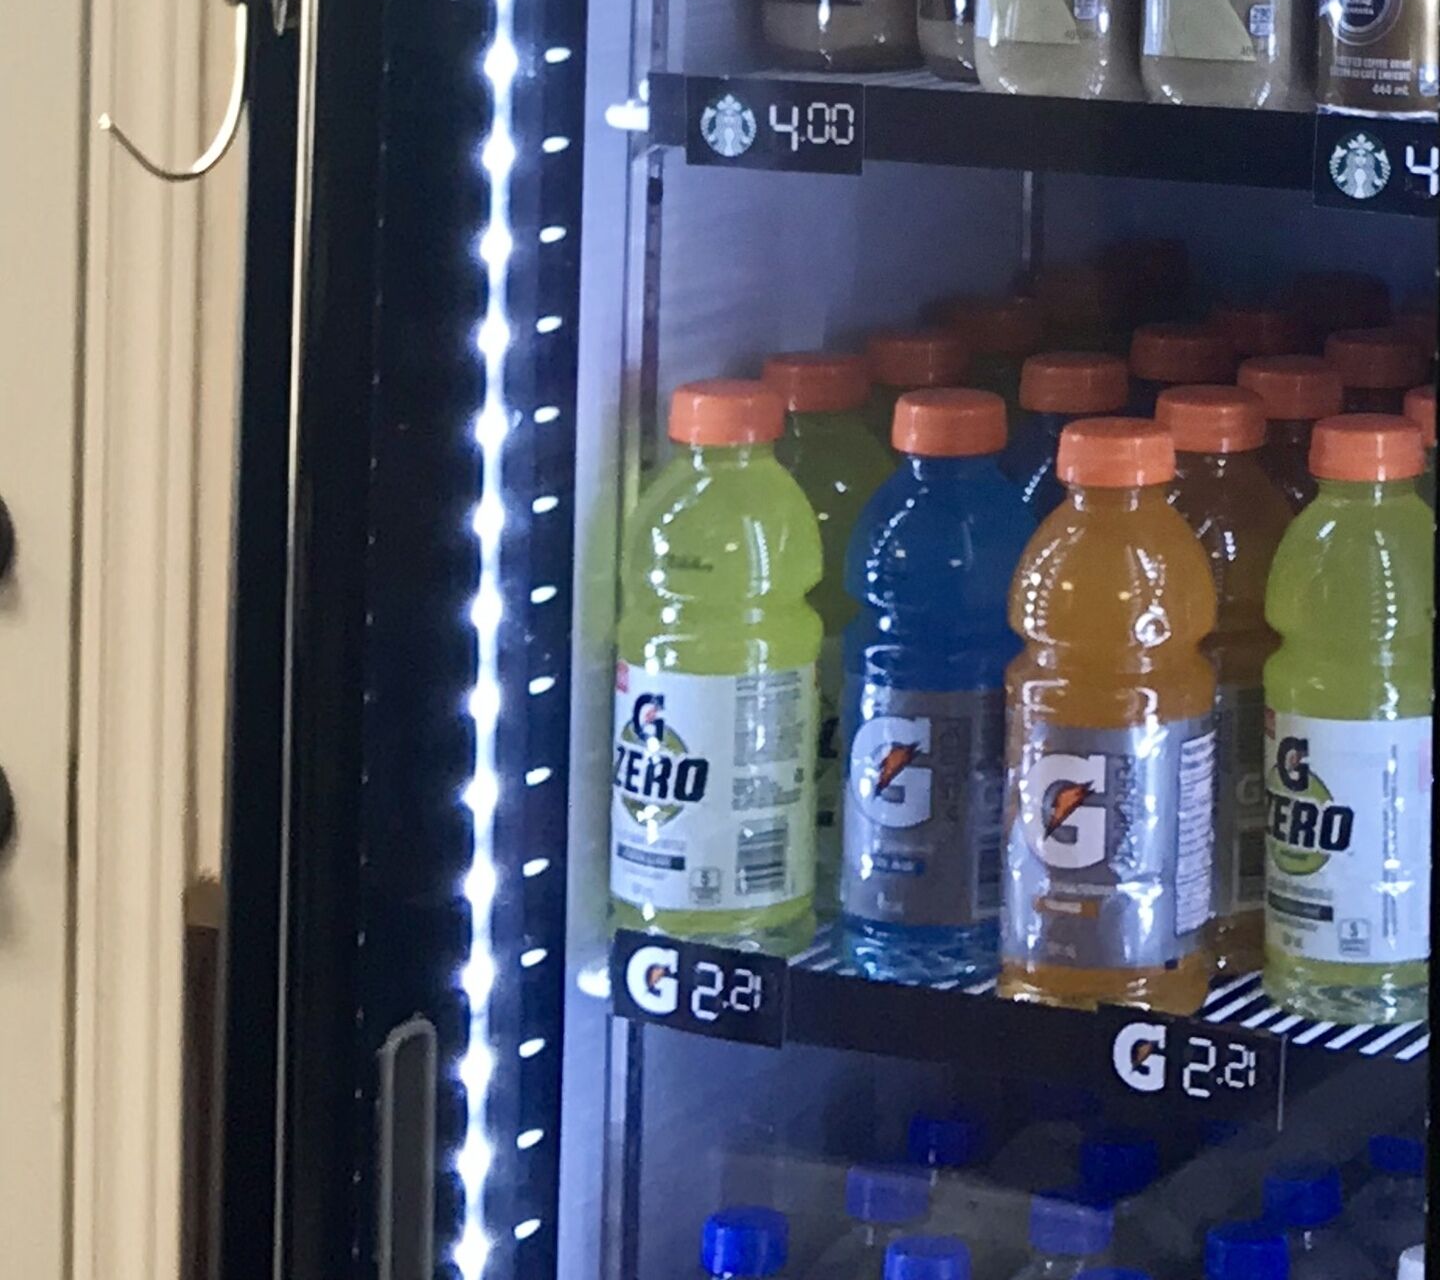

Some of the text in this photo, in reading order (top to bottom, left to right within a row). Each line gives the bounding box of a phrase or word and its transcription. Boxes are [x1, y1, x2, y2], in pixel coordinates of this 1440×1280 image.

[768, 102, 854, 152] 4.00
[851, 715, 932, 829] G
[1021, 752, 1107, 869] G
[626, 945, 679, 1015] G
[1113, 1022, 1167, 1091] G
